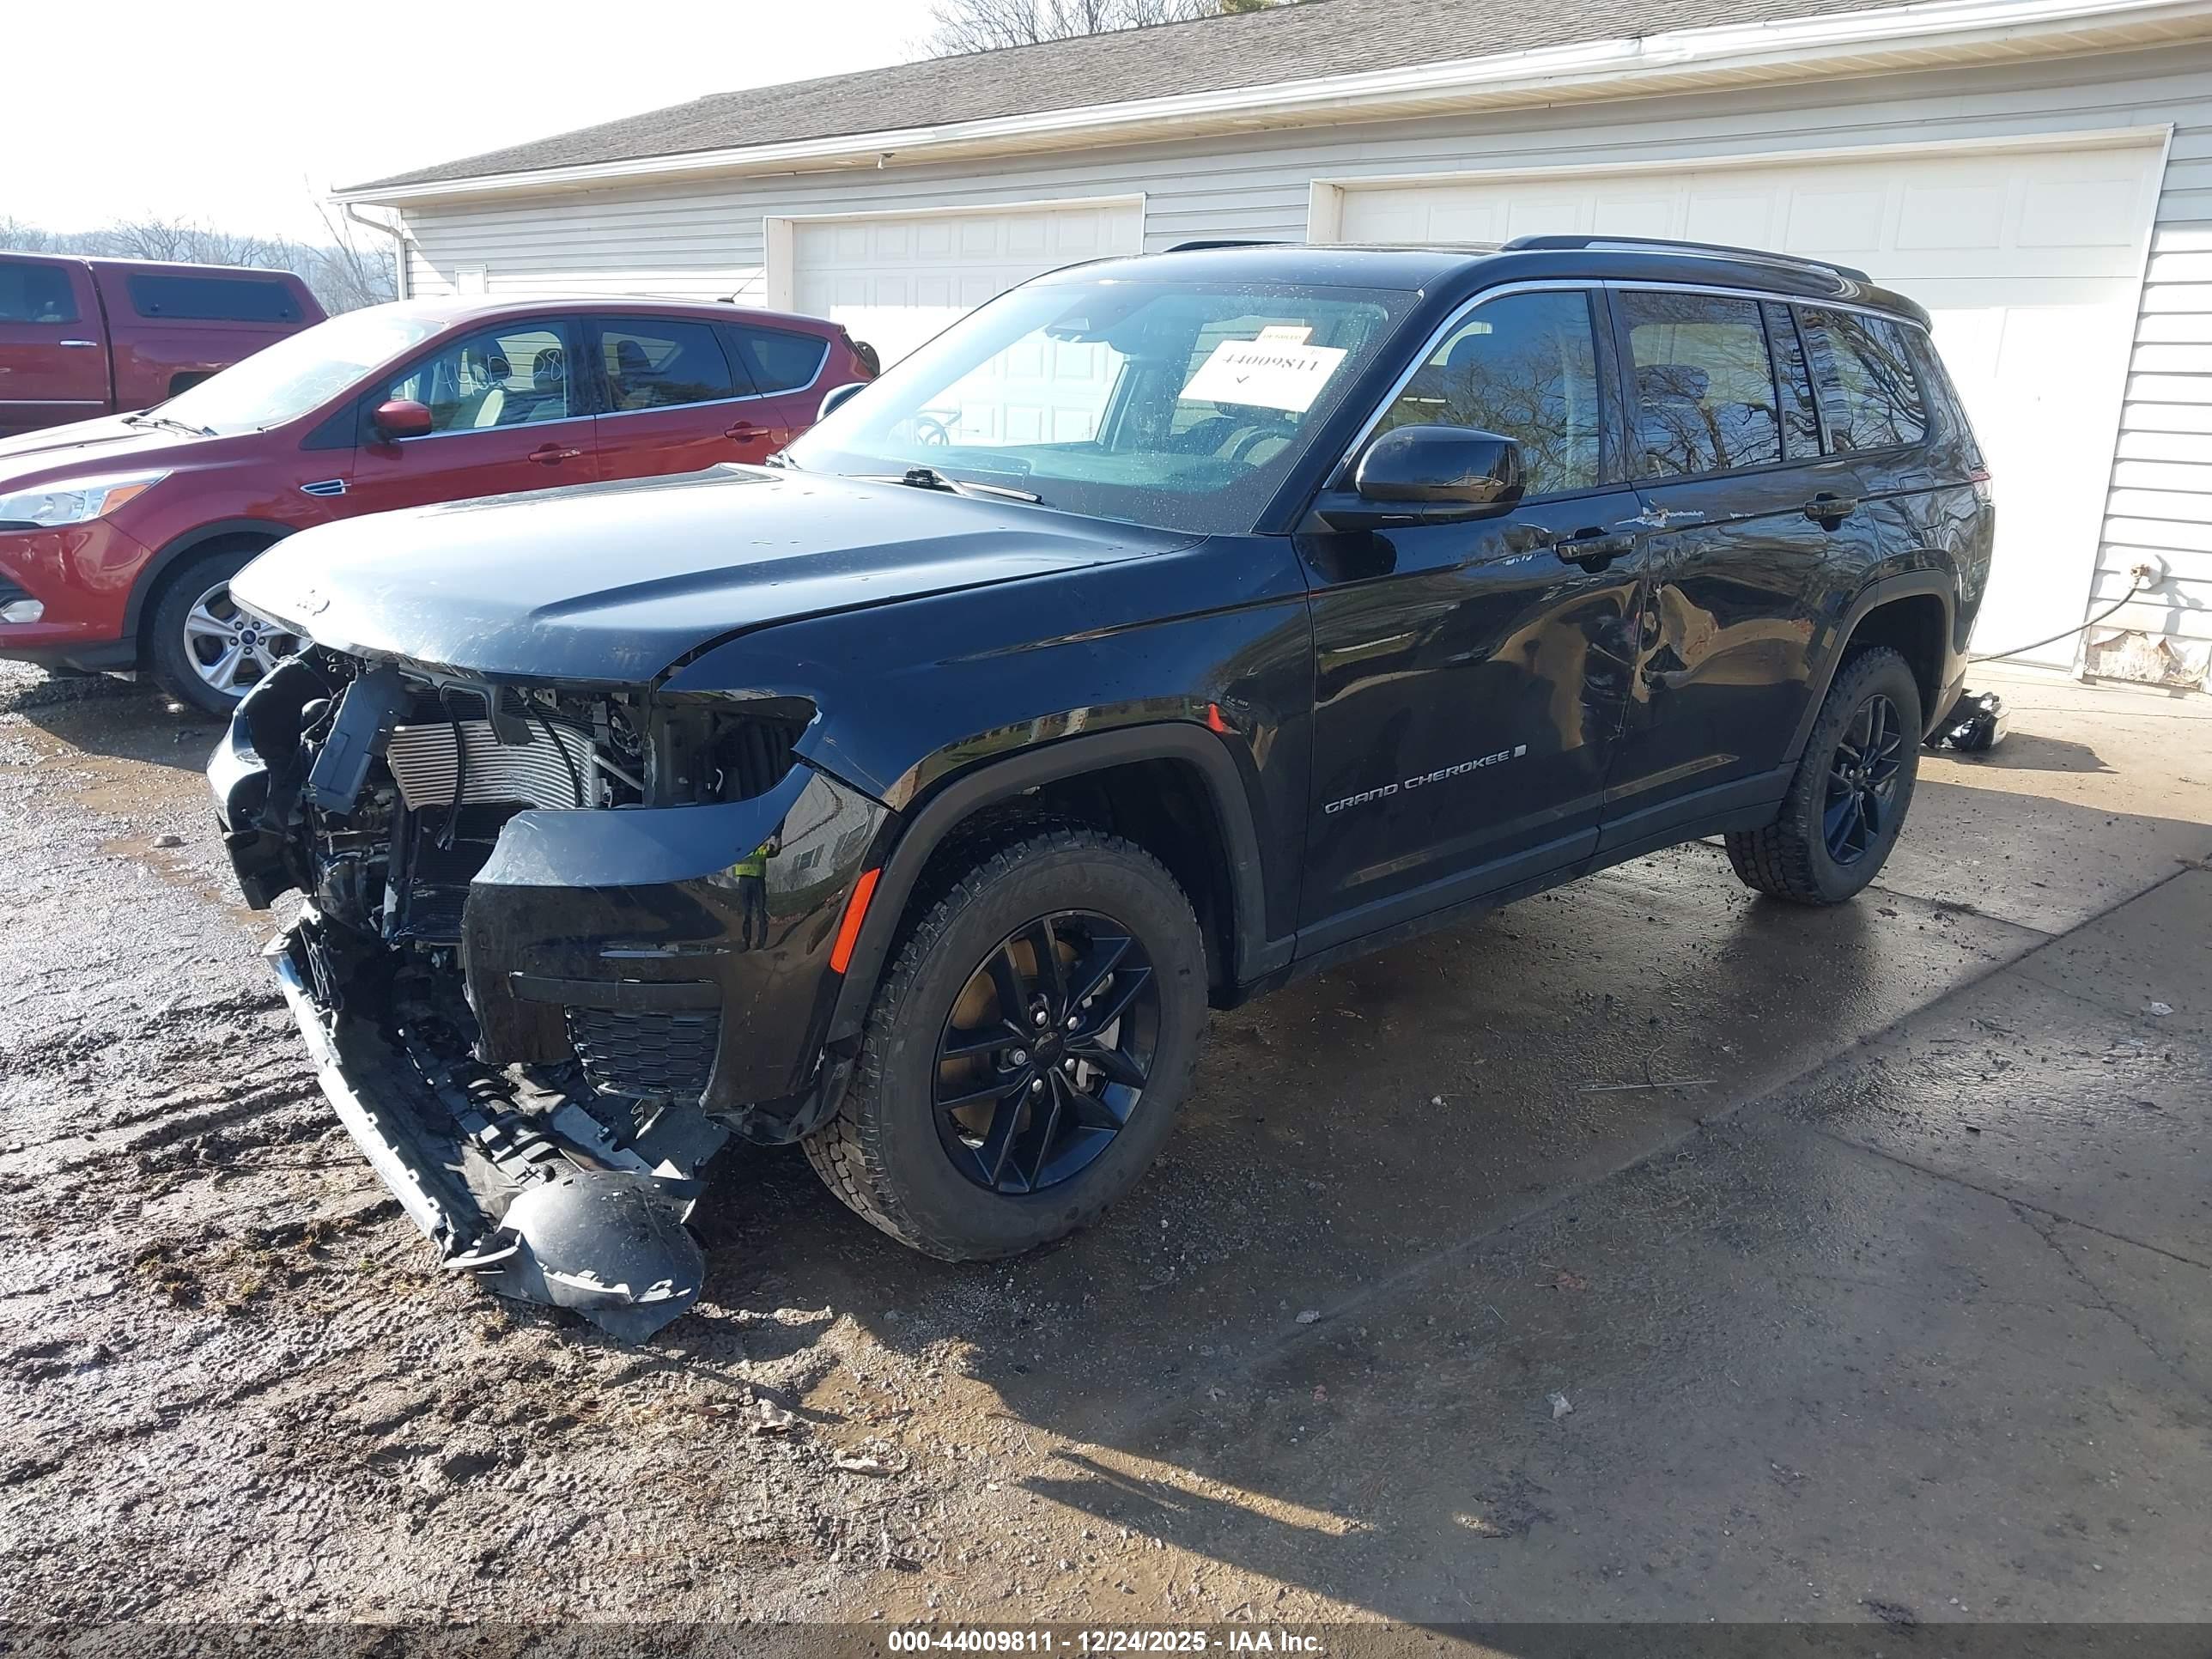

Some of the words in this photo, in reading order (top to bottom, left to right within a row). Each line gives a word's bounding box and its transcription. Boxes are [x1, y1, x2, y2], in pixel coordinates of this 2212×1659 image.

[1222, 353, 1319, 372] 44009811
[1324, 782, 1399, 815] GRAND
[1403, 750, 1510, 790] CHEROKEE
